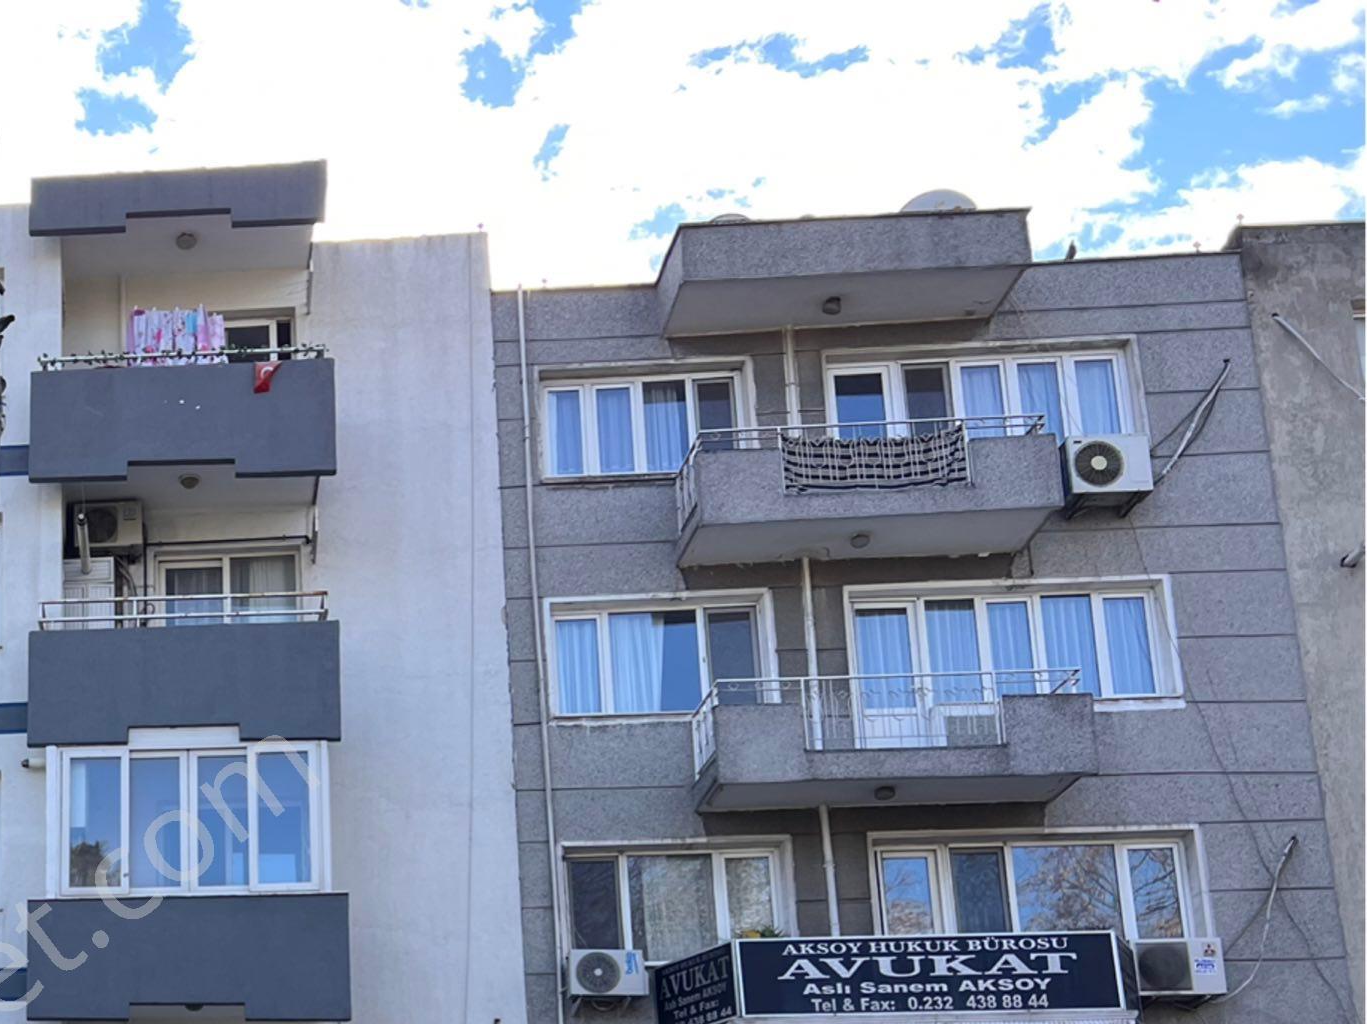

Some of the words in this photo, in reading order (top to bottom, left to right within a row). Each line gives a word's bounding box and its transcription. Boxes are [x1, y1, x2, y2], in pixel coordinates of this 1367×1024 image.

[782, 941, 863, 956] AKSOY
[869, 939, 961, 954] HUKUK
[966, 936, 1069, 951] BÜROSU
[777, 952, 1077, 980] AVUKAT
[660, 955, 730, 1000] AVUKAT
[860, 980, 948, 994] Sanem
[959, 978, 1052, 992] AKSOY
[810, 998, 837, 1012] Tel
[842, 998, 855, 1012] &
[860, 998, 896, 1012] Fax:
[907, 996, 954, 1010] 0.232
[966, 994, 997, 1009] 438
[1002, 994, 1023, 1008] 88
[1028, 993, 1050, 1008] 44
